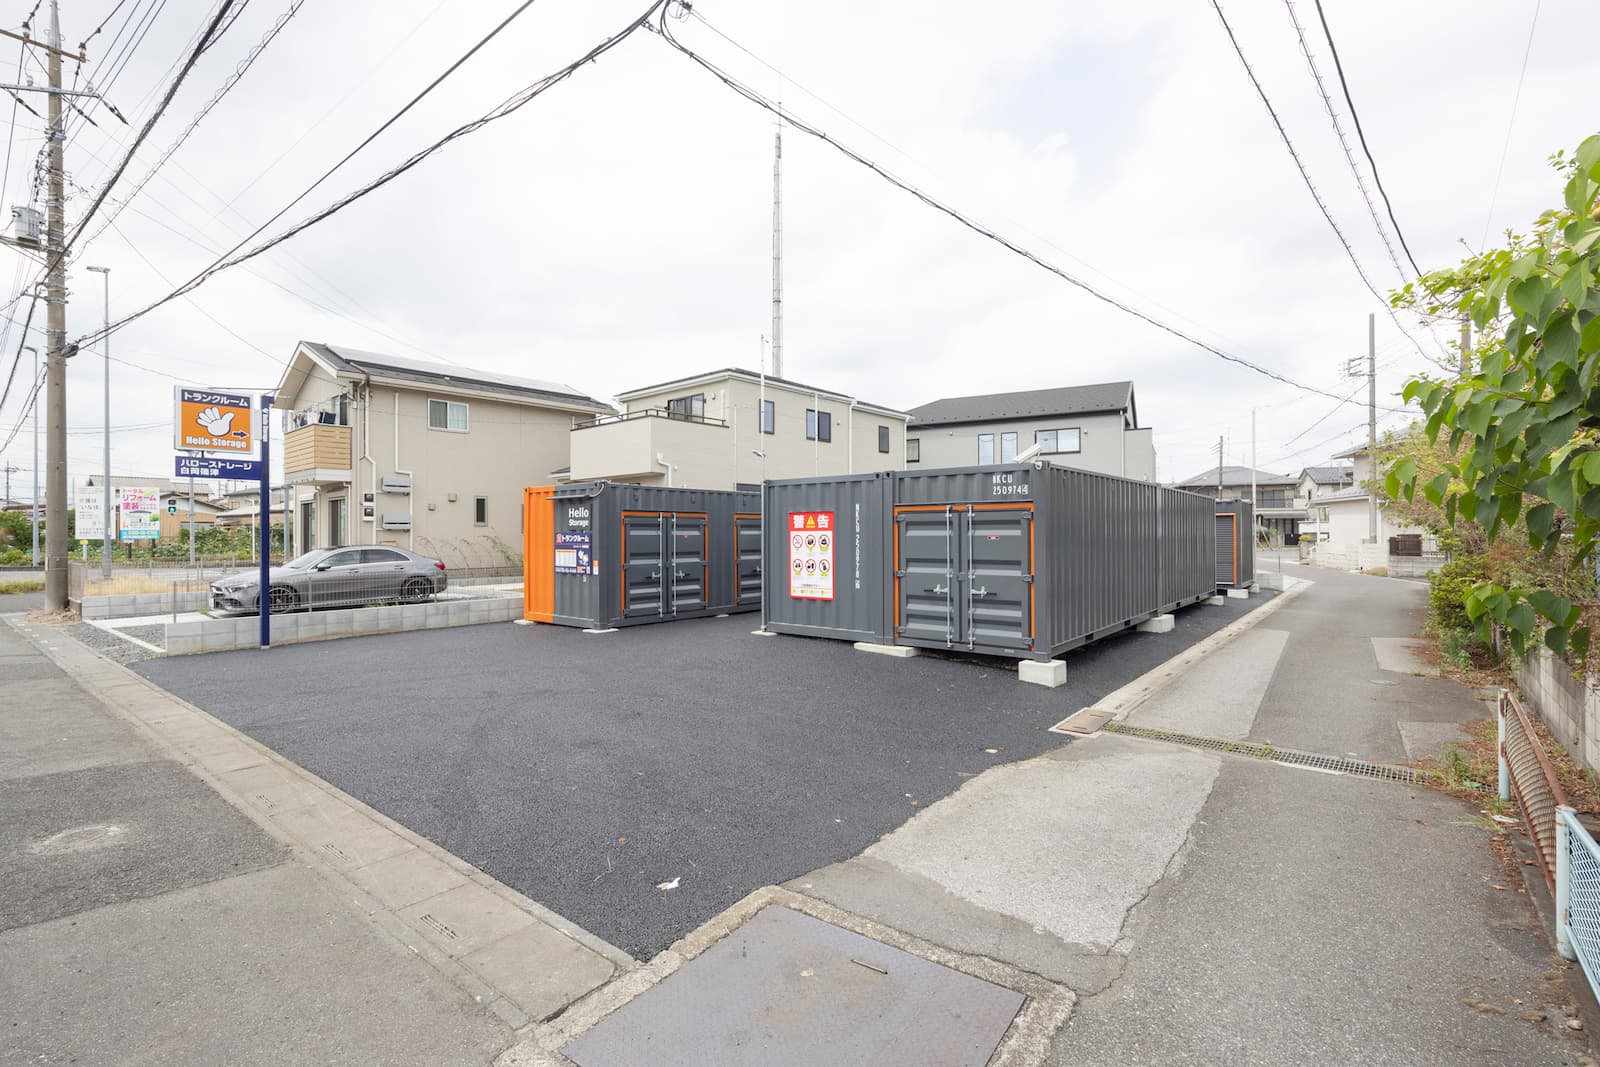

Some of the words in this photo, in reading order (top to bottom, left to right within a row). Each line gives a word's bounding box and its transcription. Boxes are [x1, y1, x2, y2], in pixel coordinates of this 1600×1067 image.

[184, 392, 248, 407] トランクルーム
[185, 435, 210, 446] Hello
[212, 438, 247, 449] Storage
[180, 459, 252, 470] ハローストレージ
[992, 474, 1013, 484] NKCU
[122, 494, 157, 502] リフォーム
[568, 507, 590, 518] Hello
[568, 519, 589, 527] Storage
